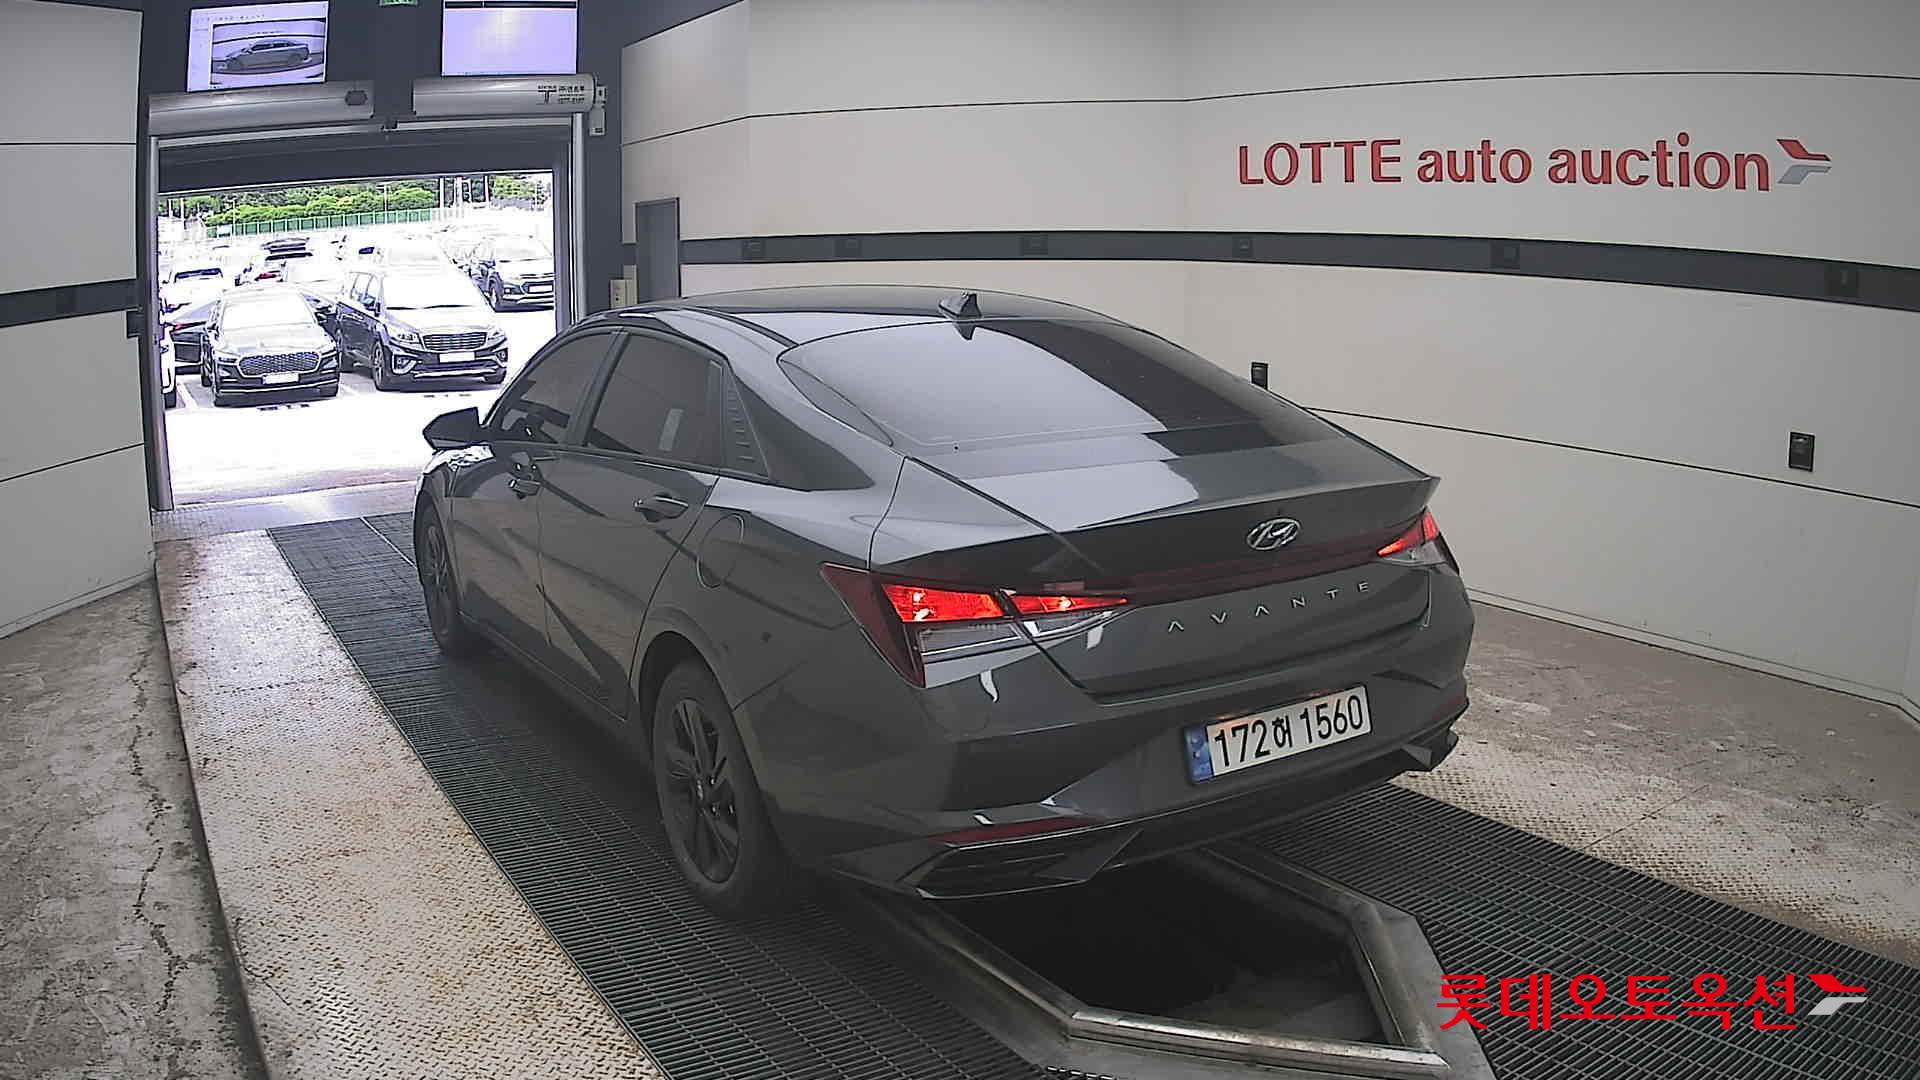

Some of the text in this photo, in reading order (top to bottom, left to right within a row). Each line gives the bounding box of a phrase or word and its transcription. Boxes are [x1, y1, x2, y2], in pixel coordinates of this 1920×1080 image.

[1238, 131, 1771, 191] LOTTE auto auction
[1167, 581, 1371, 634] AVANTE
[1213, 694, 1364, 768] 172허 1560
